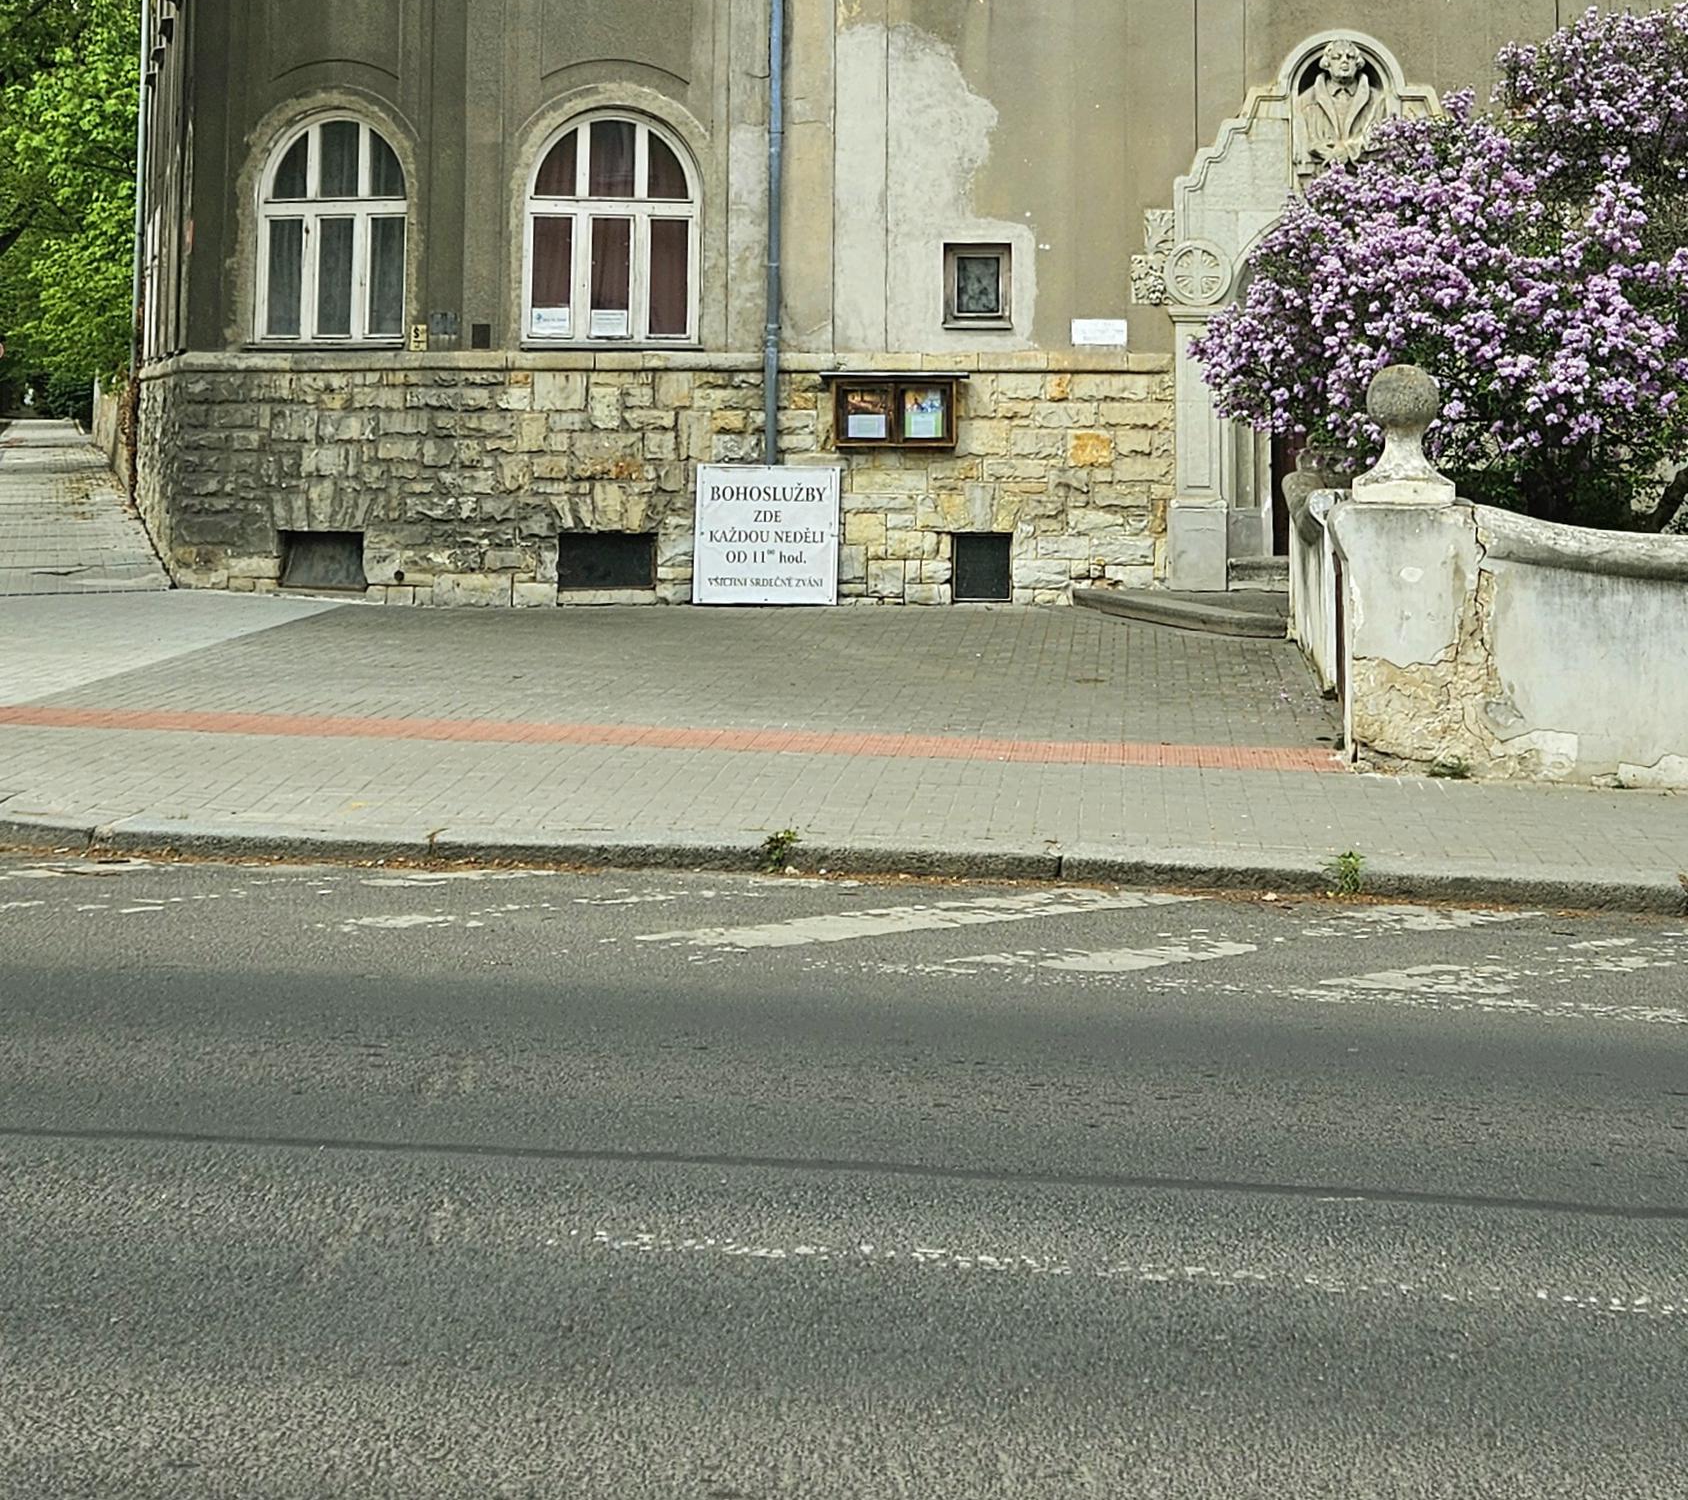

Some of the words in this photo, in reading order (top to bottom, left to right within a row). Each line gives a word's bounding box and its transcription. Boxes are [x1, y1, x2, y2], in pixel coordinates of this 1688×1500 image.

[711, 483, 826, 502] BOHOSLUŽBY
[753, 510, 782, 523] ZDE
[709, 527, 770, 543] KAŽDOU
[774, 528, 825, 544] NEDĚLI
[726, 550, 748, 564] OD
[779, 551, 807, 565] hod.
[749, 576, 793, 588] SRDEČNĚ
